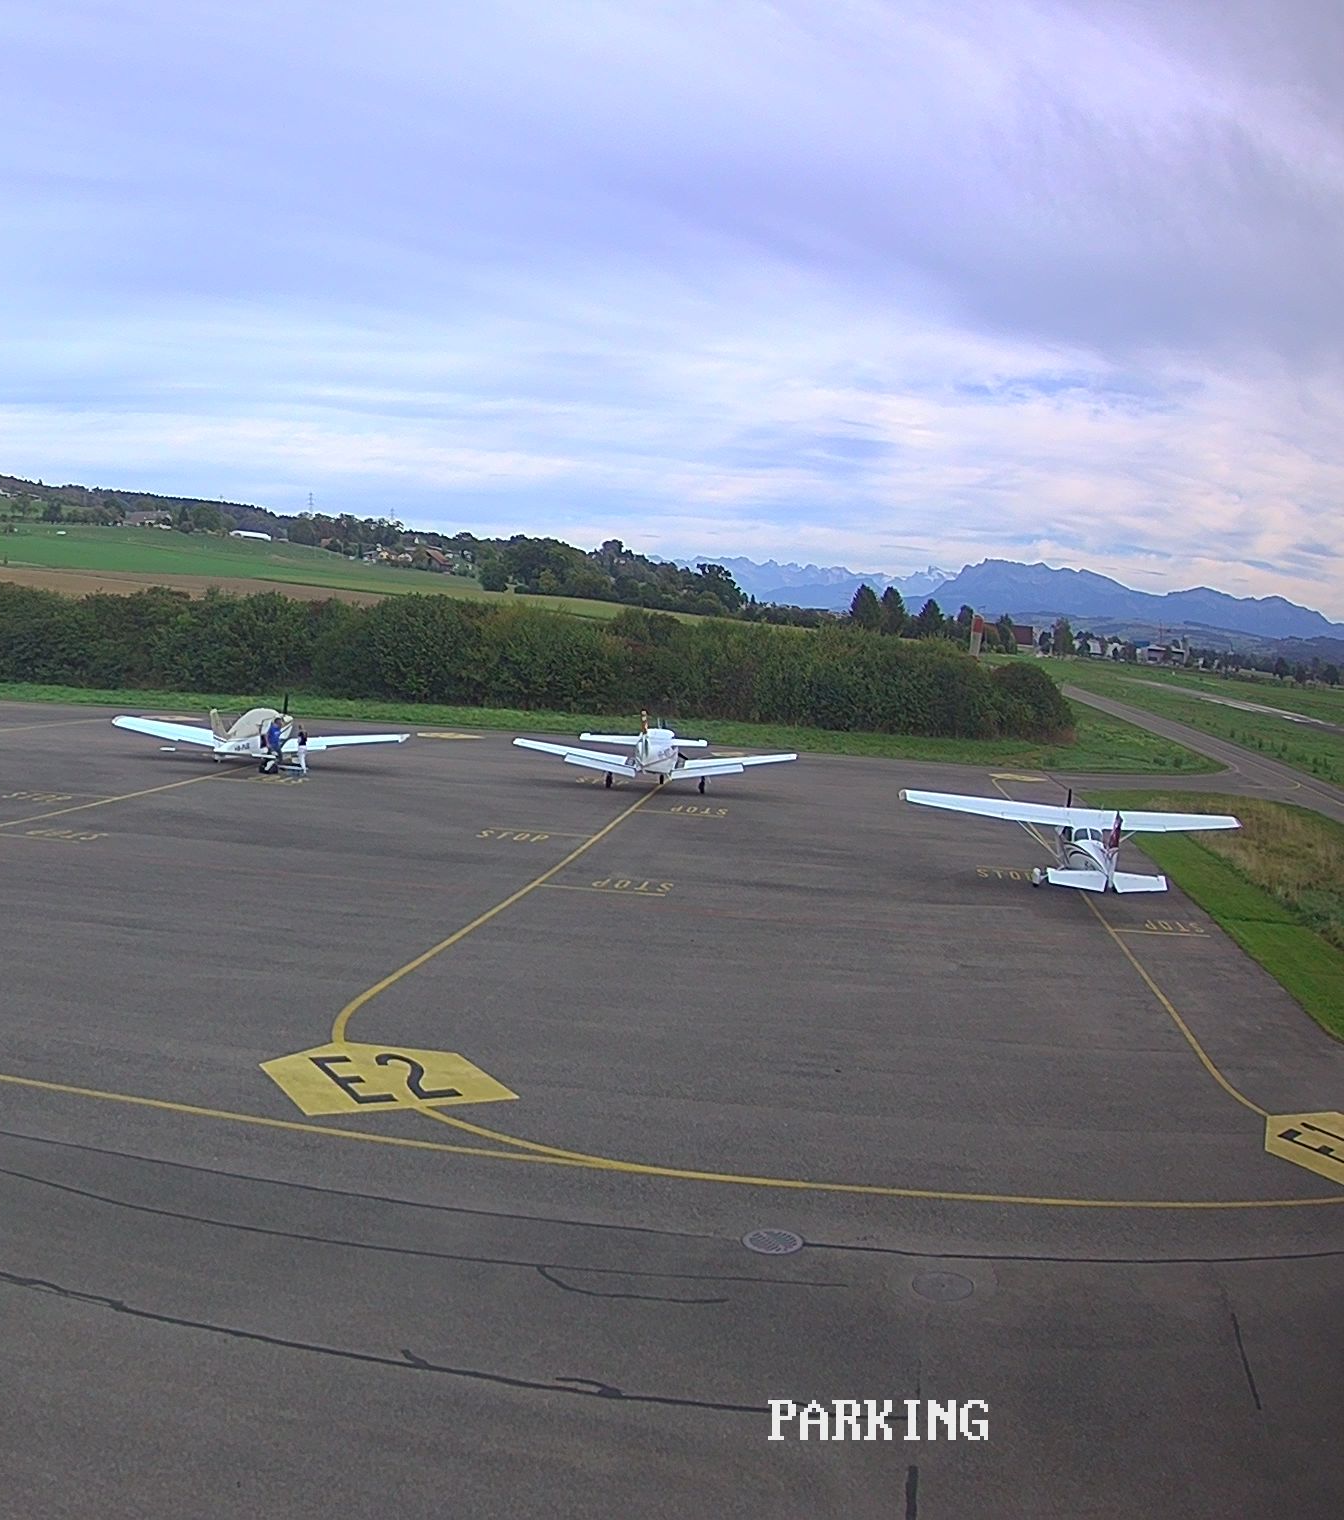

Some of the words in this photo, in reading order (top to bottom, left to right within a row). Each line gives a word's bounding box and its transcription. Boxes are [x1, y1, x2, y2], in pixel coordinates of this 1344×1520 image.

[670, 805, 729, 815] STOP
[475, 829, 550, 842] STOP
[591, 878, 675, 893] STOP
[1144, 919, 1206, 934] STOP
[309, 1053, 463, 1104] E2
